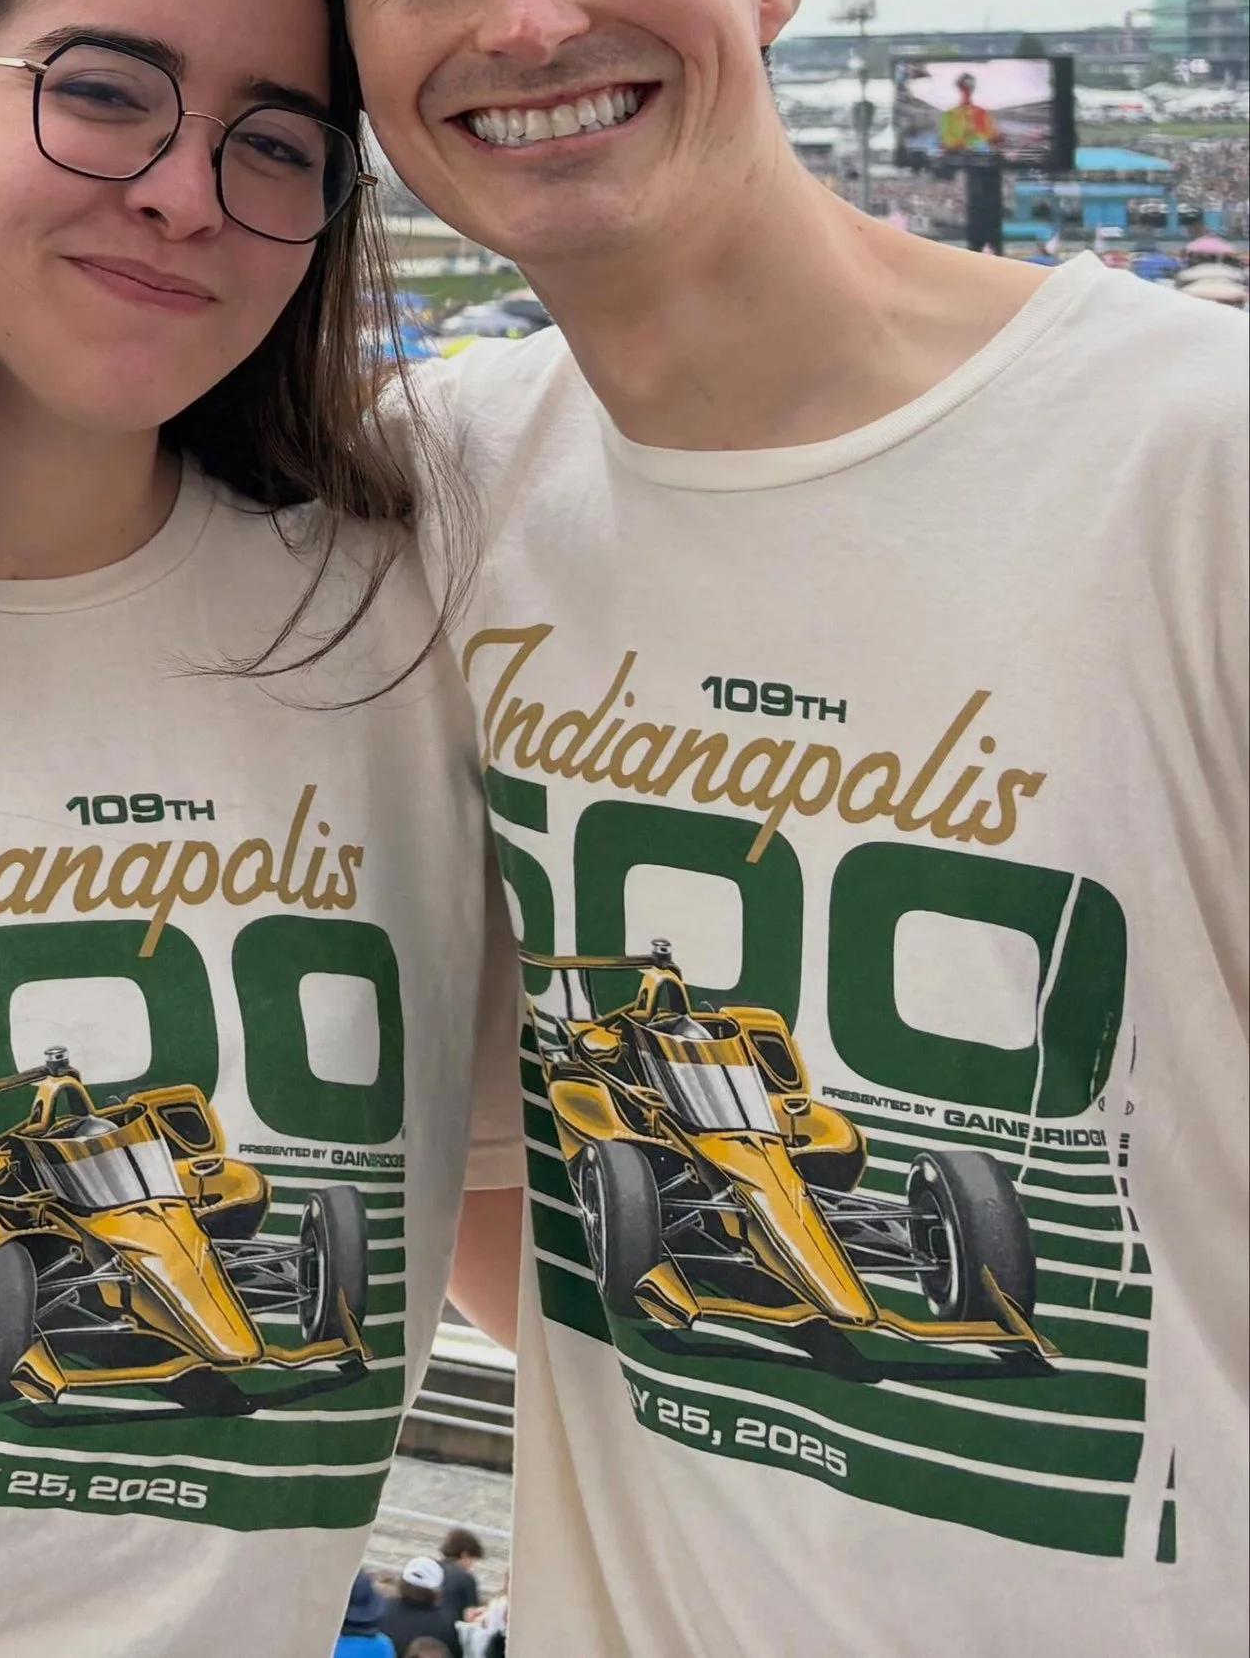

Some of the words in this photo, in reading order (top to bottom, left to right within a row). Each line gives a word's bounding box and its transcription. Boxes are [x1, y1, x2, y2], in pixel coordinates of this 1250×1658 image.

[701, 675, 847, 723] 109TH
[462, 623, 1047, 864] Indianapolis
[65, 793, 216, 826] 109TH
[821, 1086, 911, 1112] PRESENTED
[914, 1104, 936, 1117] BY
[238, 1143, 311, 1158] PRESENTED
[313, 1148, 327, 1160] BY
[657, 1397, 722, 1446] 25,
[735, 1417, 848, 1477] 2025
[8, 1471, 77, 1502] 25,
[88, 1475, 209, 1509] 2025
